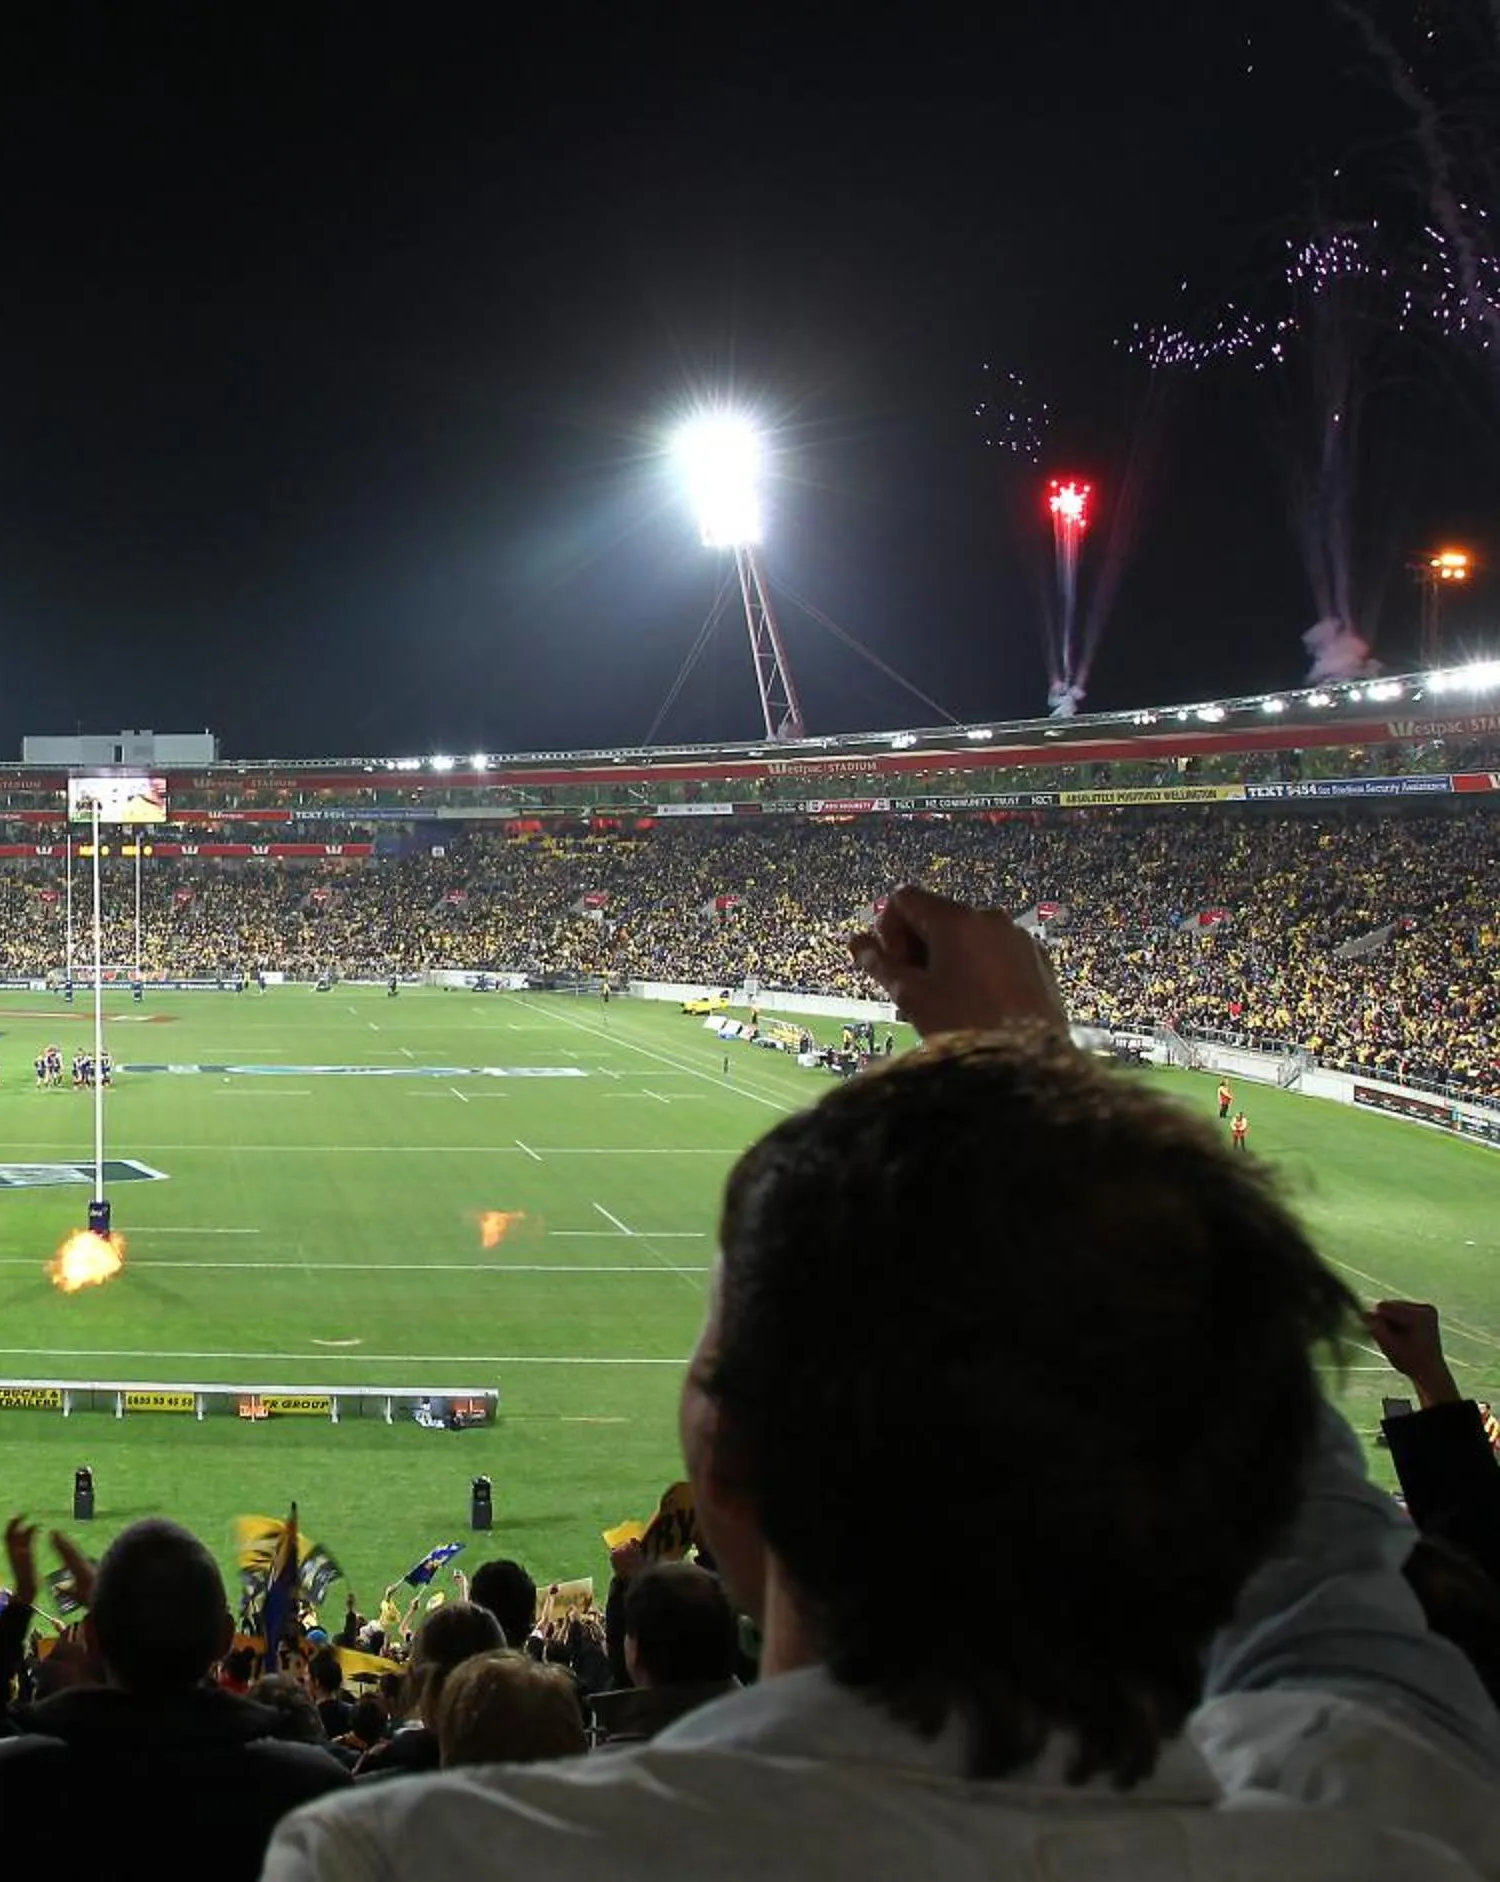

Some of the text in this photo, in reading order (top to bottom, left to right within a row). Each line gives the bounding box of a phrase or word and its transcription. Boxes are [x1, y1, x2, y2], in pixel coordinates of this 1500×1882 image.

[1387, 721, 1463, 737] Westpac
[827, 761, 876, 772] STADIUM
[1248, 787, 1284, 798] TEXT
[281, 1400, 330, 1410] GROUP
